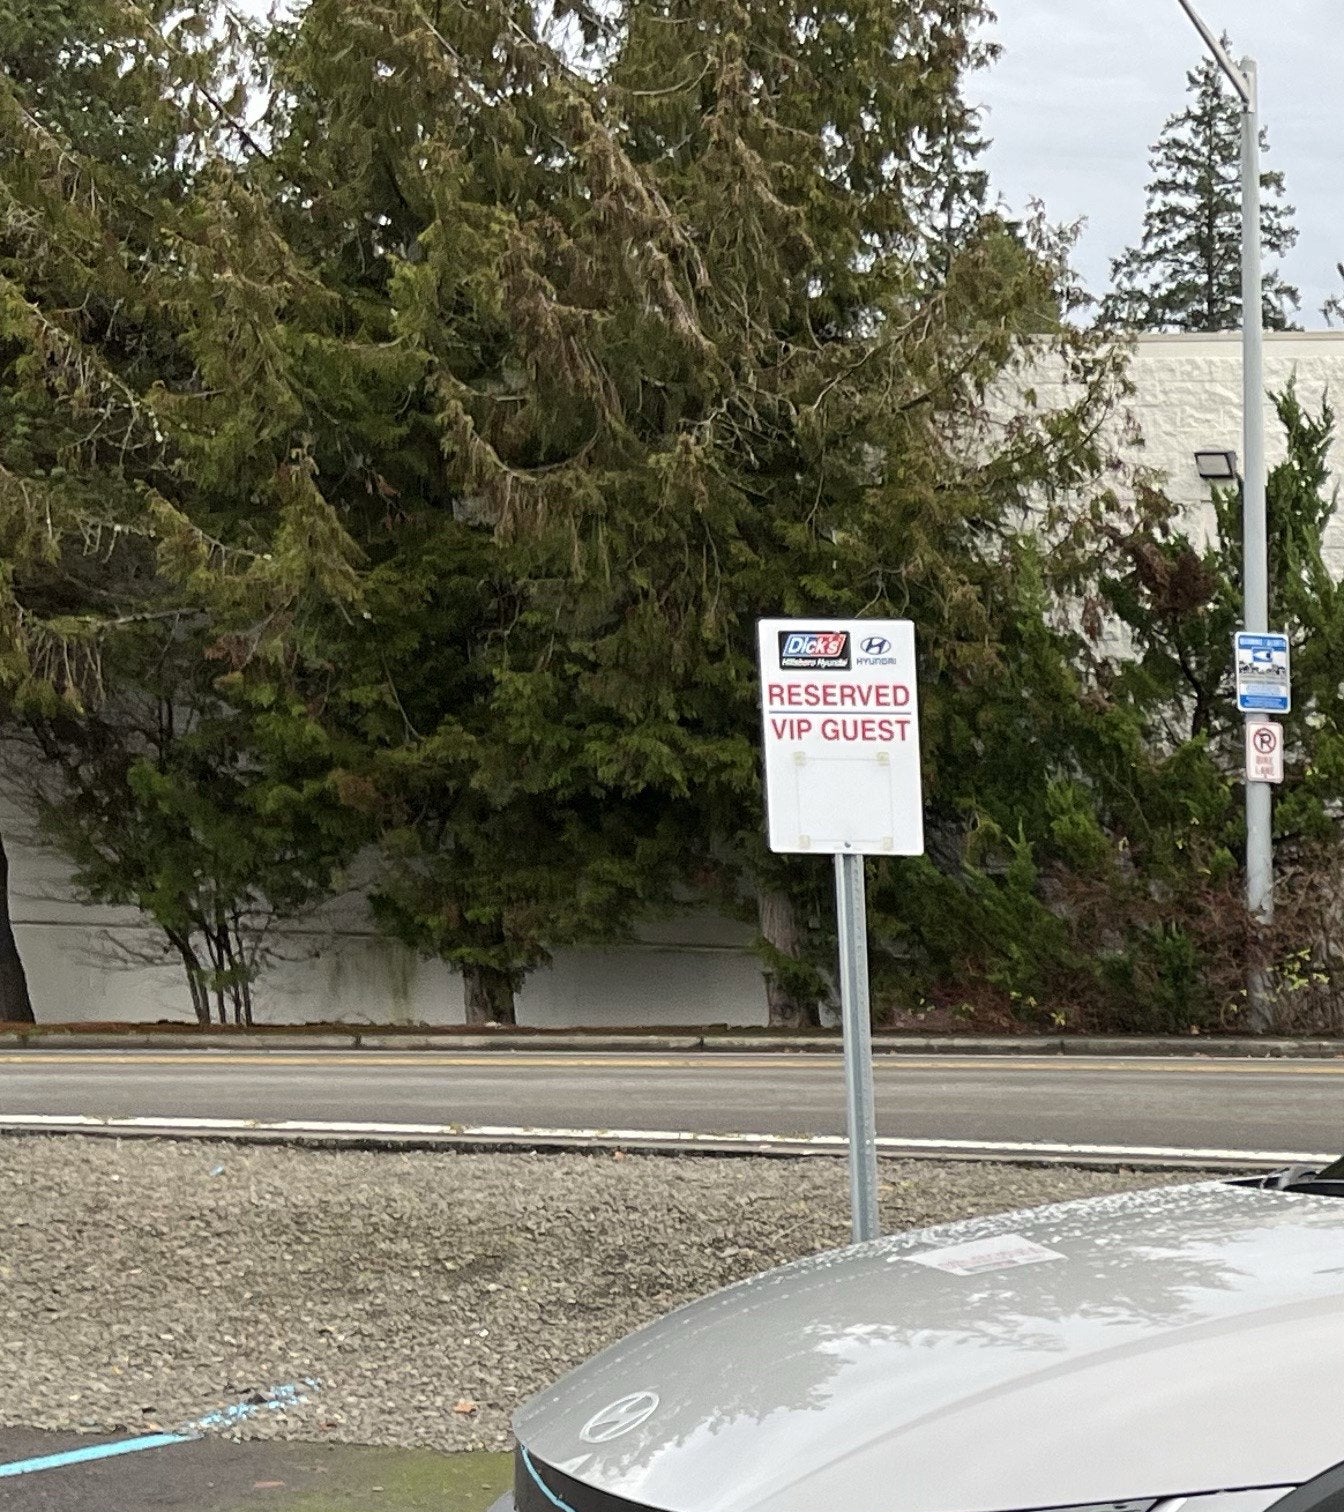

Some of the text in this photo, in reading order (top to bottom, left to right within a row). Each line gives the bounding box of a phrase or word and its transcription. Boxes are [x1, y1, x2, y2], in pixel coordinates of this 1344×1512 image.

[856, 657, 897, 666] HYUNDAI
[768, 683, 911, 708] RESERVED
[771, 718, 912, 742] VIP GUEST
